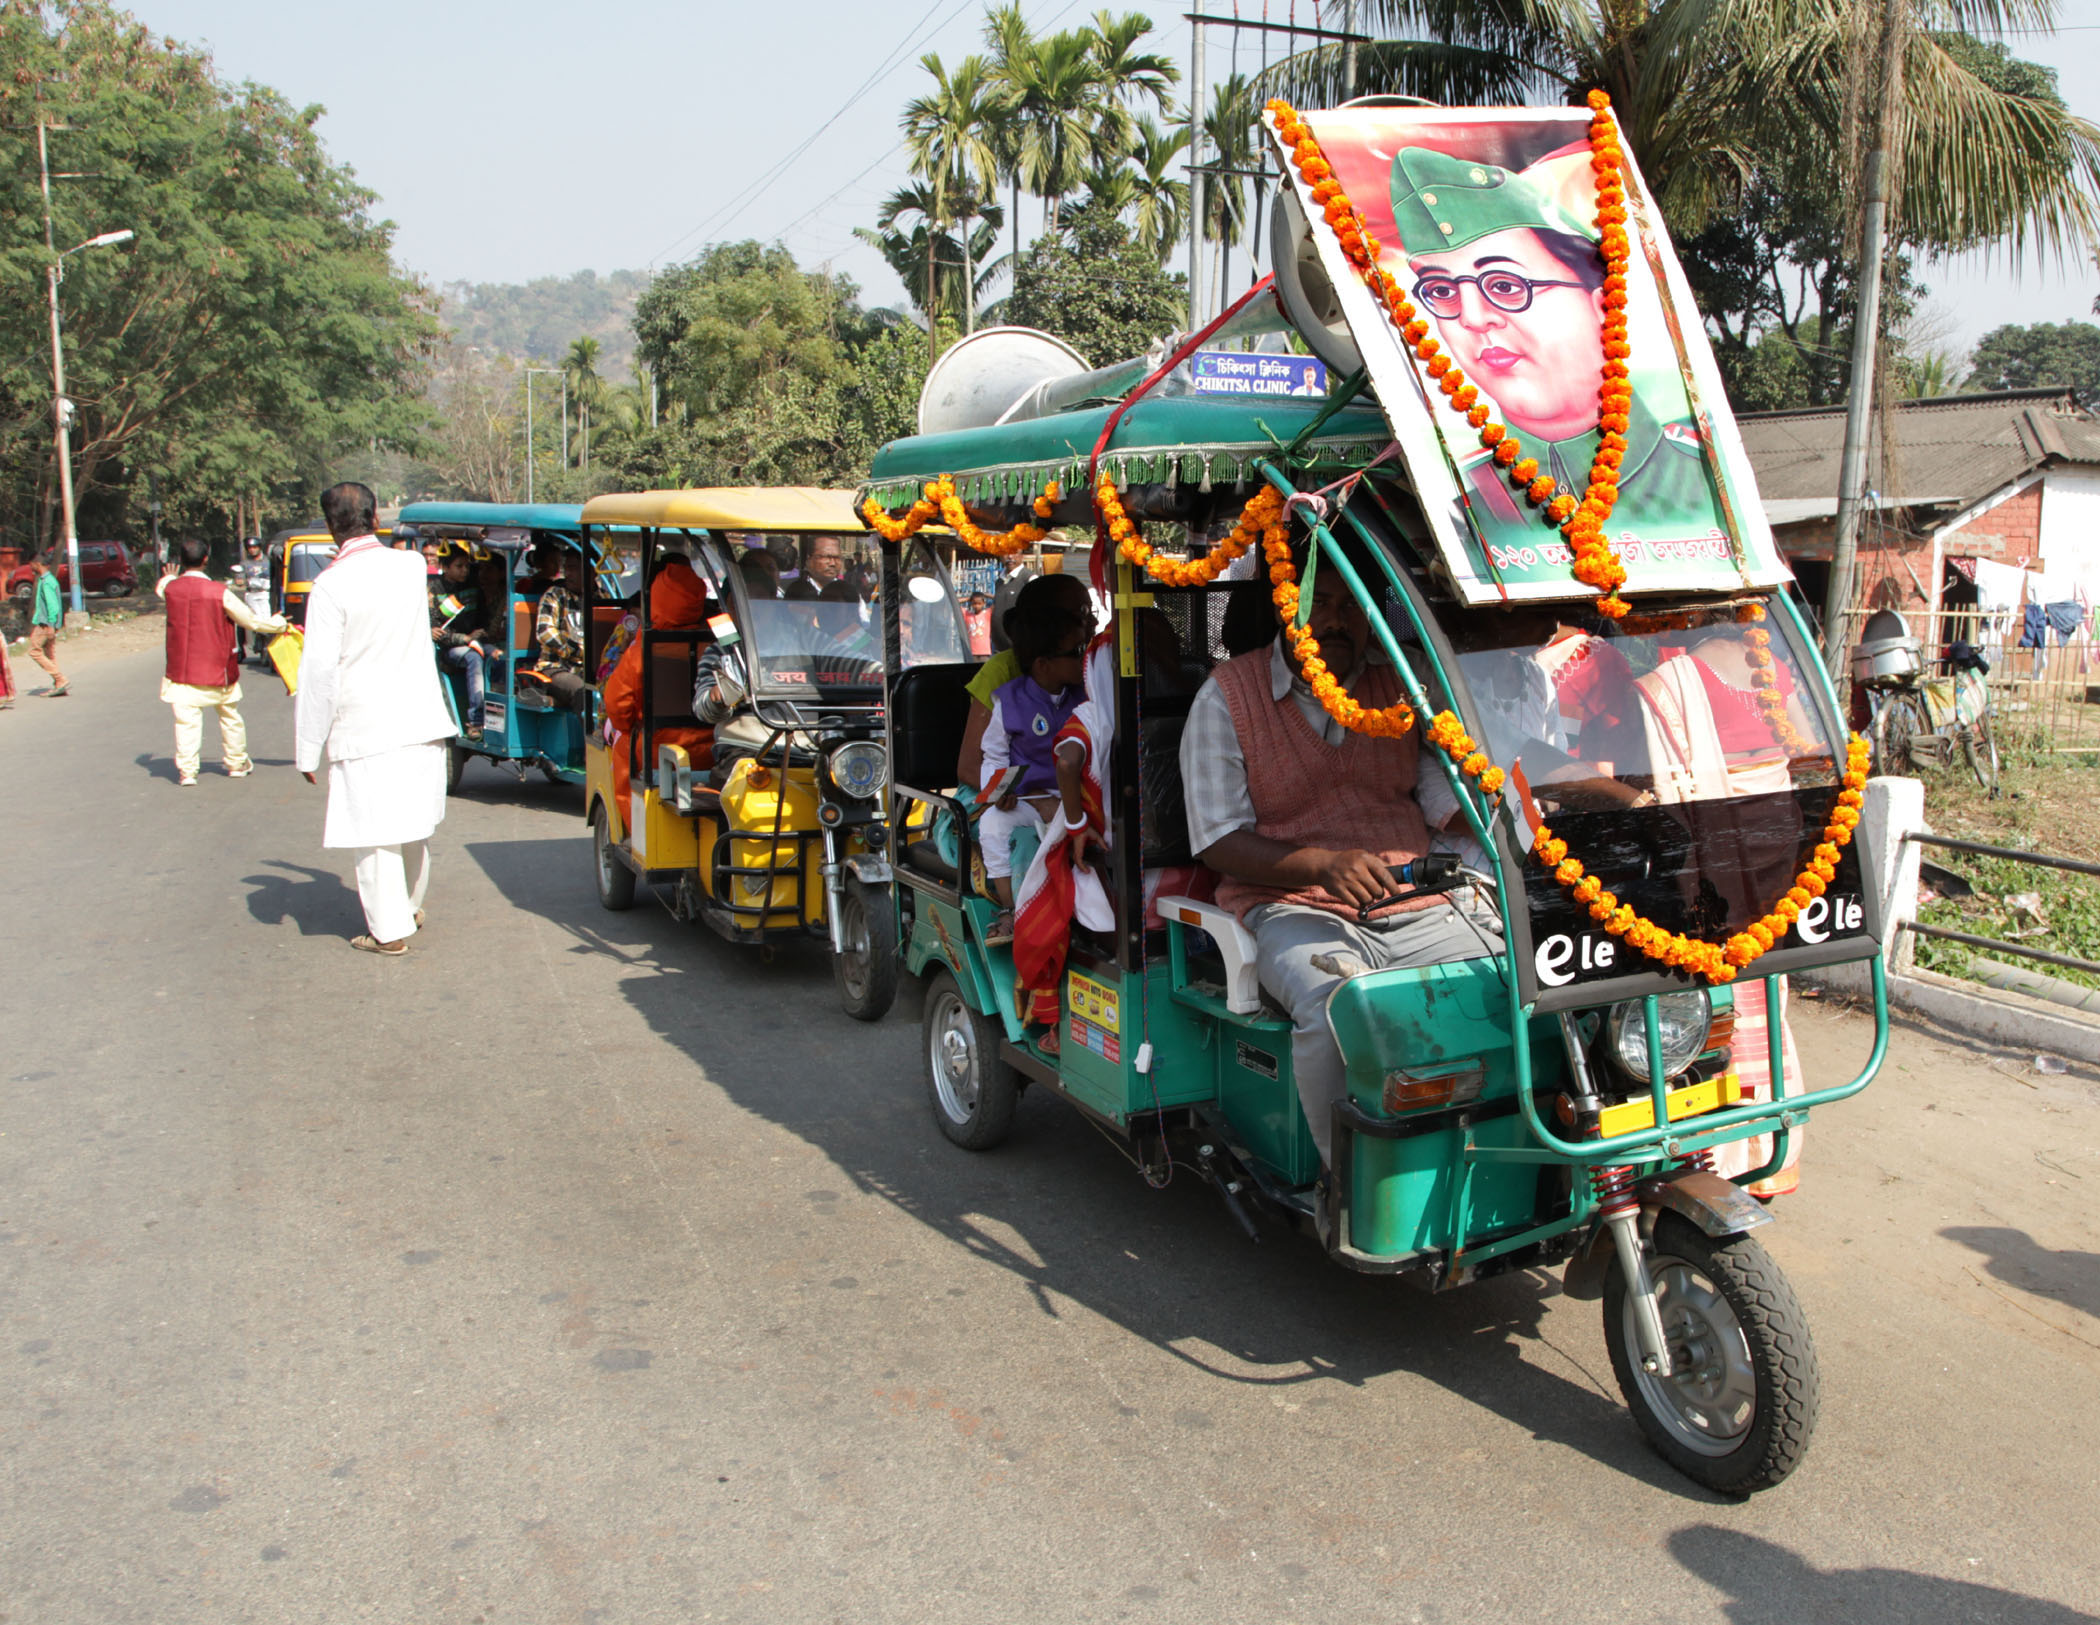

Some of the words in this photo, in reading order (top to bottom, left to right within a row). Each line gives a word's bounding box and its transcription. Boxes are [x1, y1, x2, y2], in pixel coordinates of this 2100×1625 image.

[1217, 358, 1256, 376] চিকিৎসা
[1259, 360, 1291, 378] ক্লিনিক
[1194, 377, 1251, 393] CHIKITSA
[1252, 380, 1292, 395] CLINIC
[1491, 544, 1538, 571] ১২০
[771, 671, 808, 684] जय
